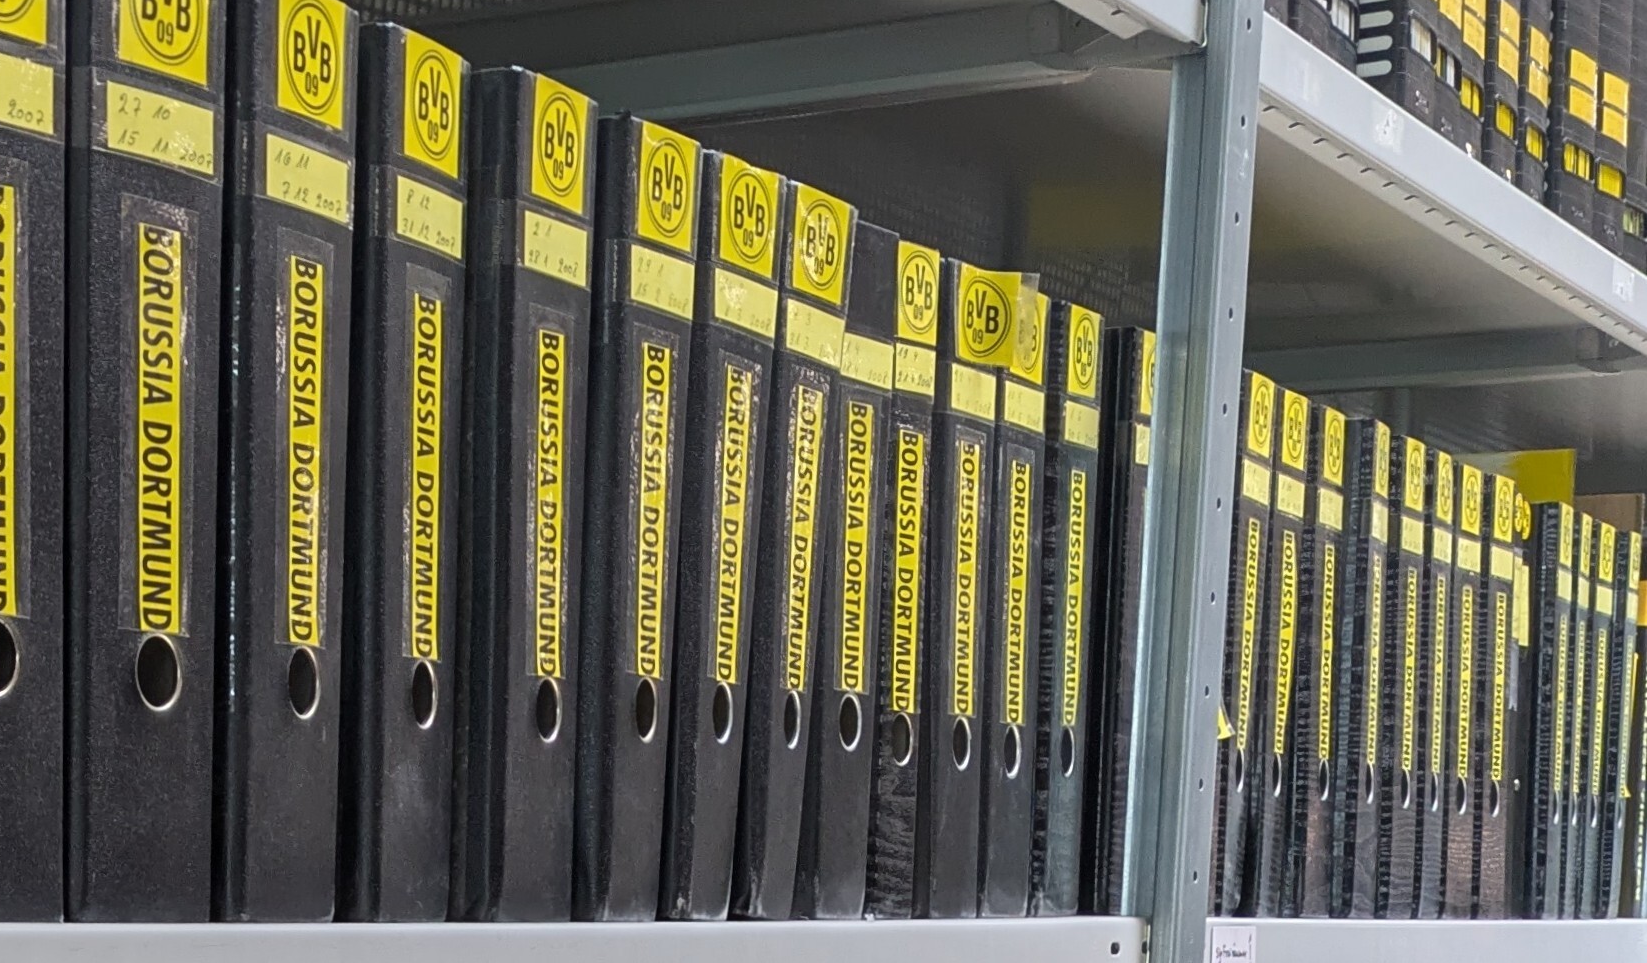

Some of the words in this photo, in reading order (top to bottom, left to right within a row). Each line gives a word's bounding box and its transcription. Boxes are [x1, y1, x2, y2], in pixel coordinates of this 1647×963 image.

[156, 20, 175, 46] 09
[293, 15, 331, 84] BVB
[304, 70, 320, 97] 09
[7, 97, 46, 126] 2007
[118, 93, 142, 117] 27
[151, 103, 171, 122] 10
[418, 66, 450, 131] BVB
[427, 119, 439, 145] 09
[545, 106, 575, 169] BVB
[315, 191, 343, 216] 2007
[552, 156, 565, 180] 09
[653, 152, 683, 210] BVB
[661, 202, 672, 222] 09
[734, 181, 765, 238] BVB
[742, 228, 754, 249] 09
[905, 263, 933, 310] BVB
[141, 225, 176, 406] BORUSSIA
[291, 258, 319, 428] BORUSSIA
[913, 303, 924, 321] 09
[966, 288, 1000, 334] BVB
[972, 327, 983, 345] 09
[1076, 324, 1093, 367] BVB
[415, 294, 437, 458] BORUSSIA
[540, 331, 561, 487] BORUSSIA
[641, 344, 665, 492] BORUSSIA
[724, 367, 750, 508] BORUSSIA
[793, 387, 818, 523] BORUSSIA
[847, 404, 868, 530] BORUSSIA
[141, 421, 175, 632] DORTMUND
[290, 441, 315, 642] DORTMUND
[898, 431, 920, 558] BORUSSIA
[959, 442, 977, 565] BORUSSIA
[1012, 462, 1027, 579] BORUSSIA
[1068, 472, 1084, 587] BORUSSIA
[413, 470, 436, 658] DORTMUND
[539, 500, 559, 677] DORTMUND
[638, 507, 659, 676] DORTMUND
[716, 519, 740, 681] DORTMUND
[788, 538, 809, 689] DORTMUND
[842, 539, 864, 690] DORTMUND
[1244, 520, 1258, 622] BORUSSIA
[1281, 532, 1294, 631] BORUSSIA
[1323, 546, 1334, 642] BORUSSIA
[1406, 568, 1416, 658] BORUSSIA
[894, 567, 915, 711] DORTMUND
[955, 574, 972, 714] DORTMUND
[1008, 588, 1023, 722] DORTMUND
[1063, 594, 1079, 725] DORTMUND
[1462, 587, 1471, 672] BORUSSIA
[1496, 593, 1505, 677] BORUSSIA
[1237, 630, 1252, 749] DORTMUND
[1275, 637, 1290, 753] DORTMUND
[1320, 647, 1331, 760] DORTMUND
[1403, 665, 1413, 769] DORTMUND
[1458, 679, 1469, 777] DORTMUND
[1492, 683, 1502, 779] DORTMUND
